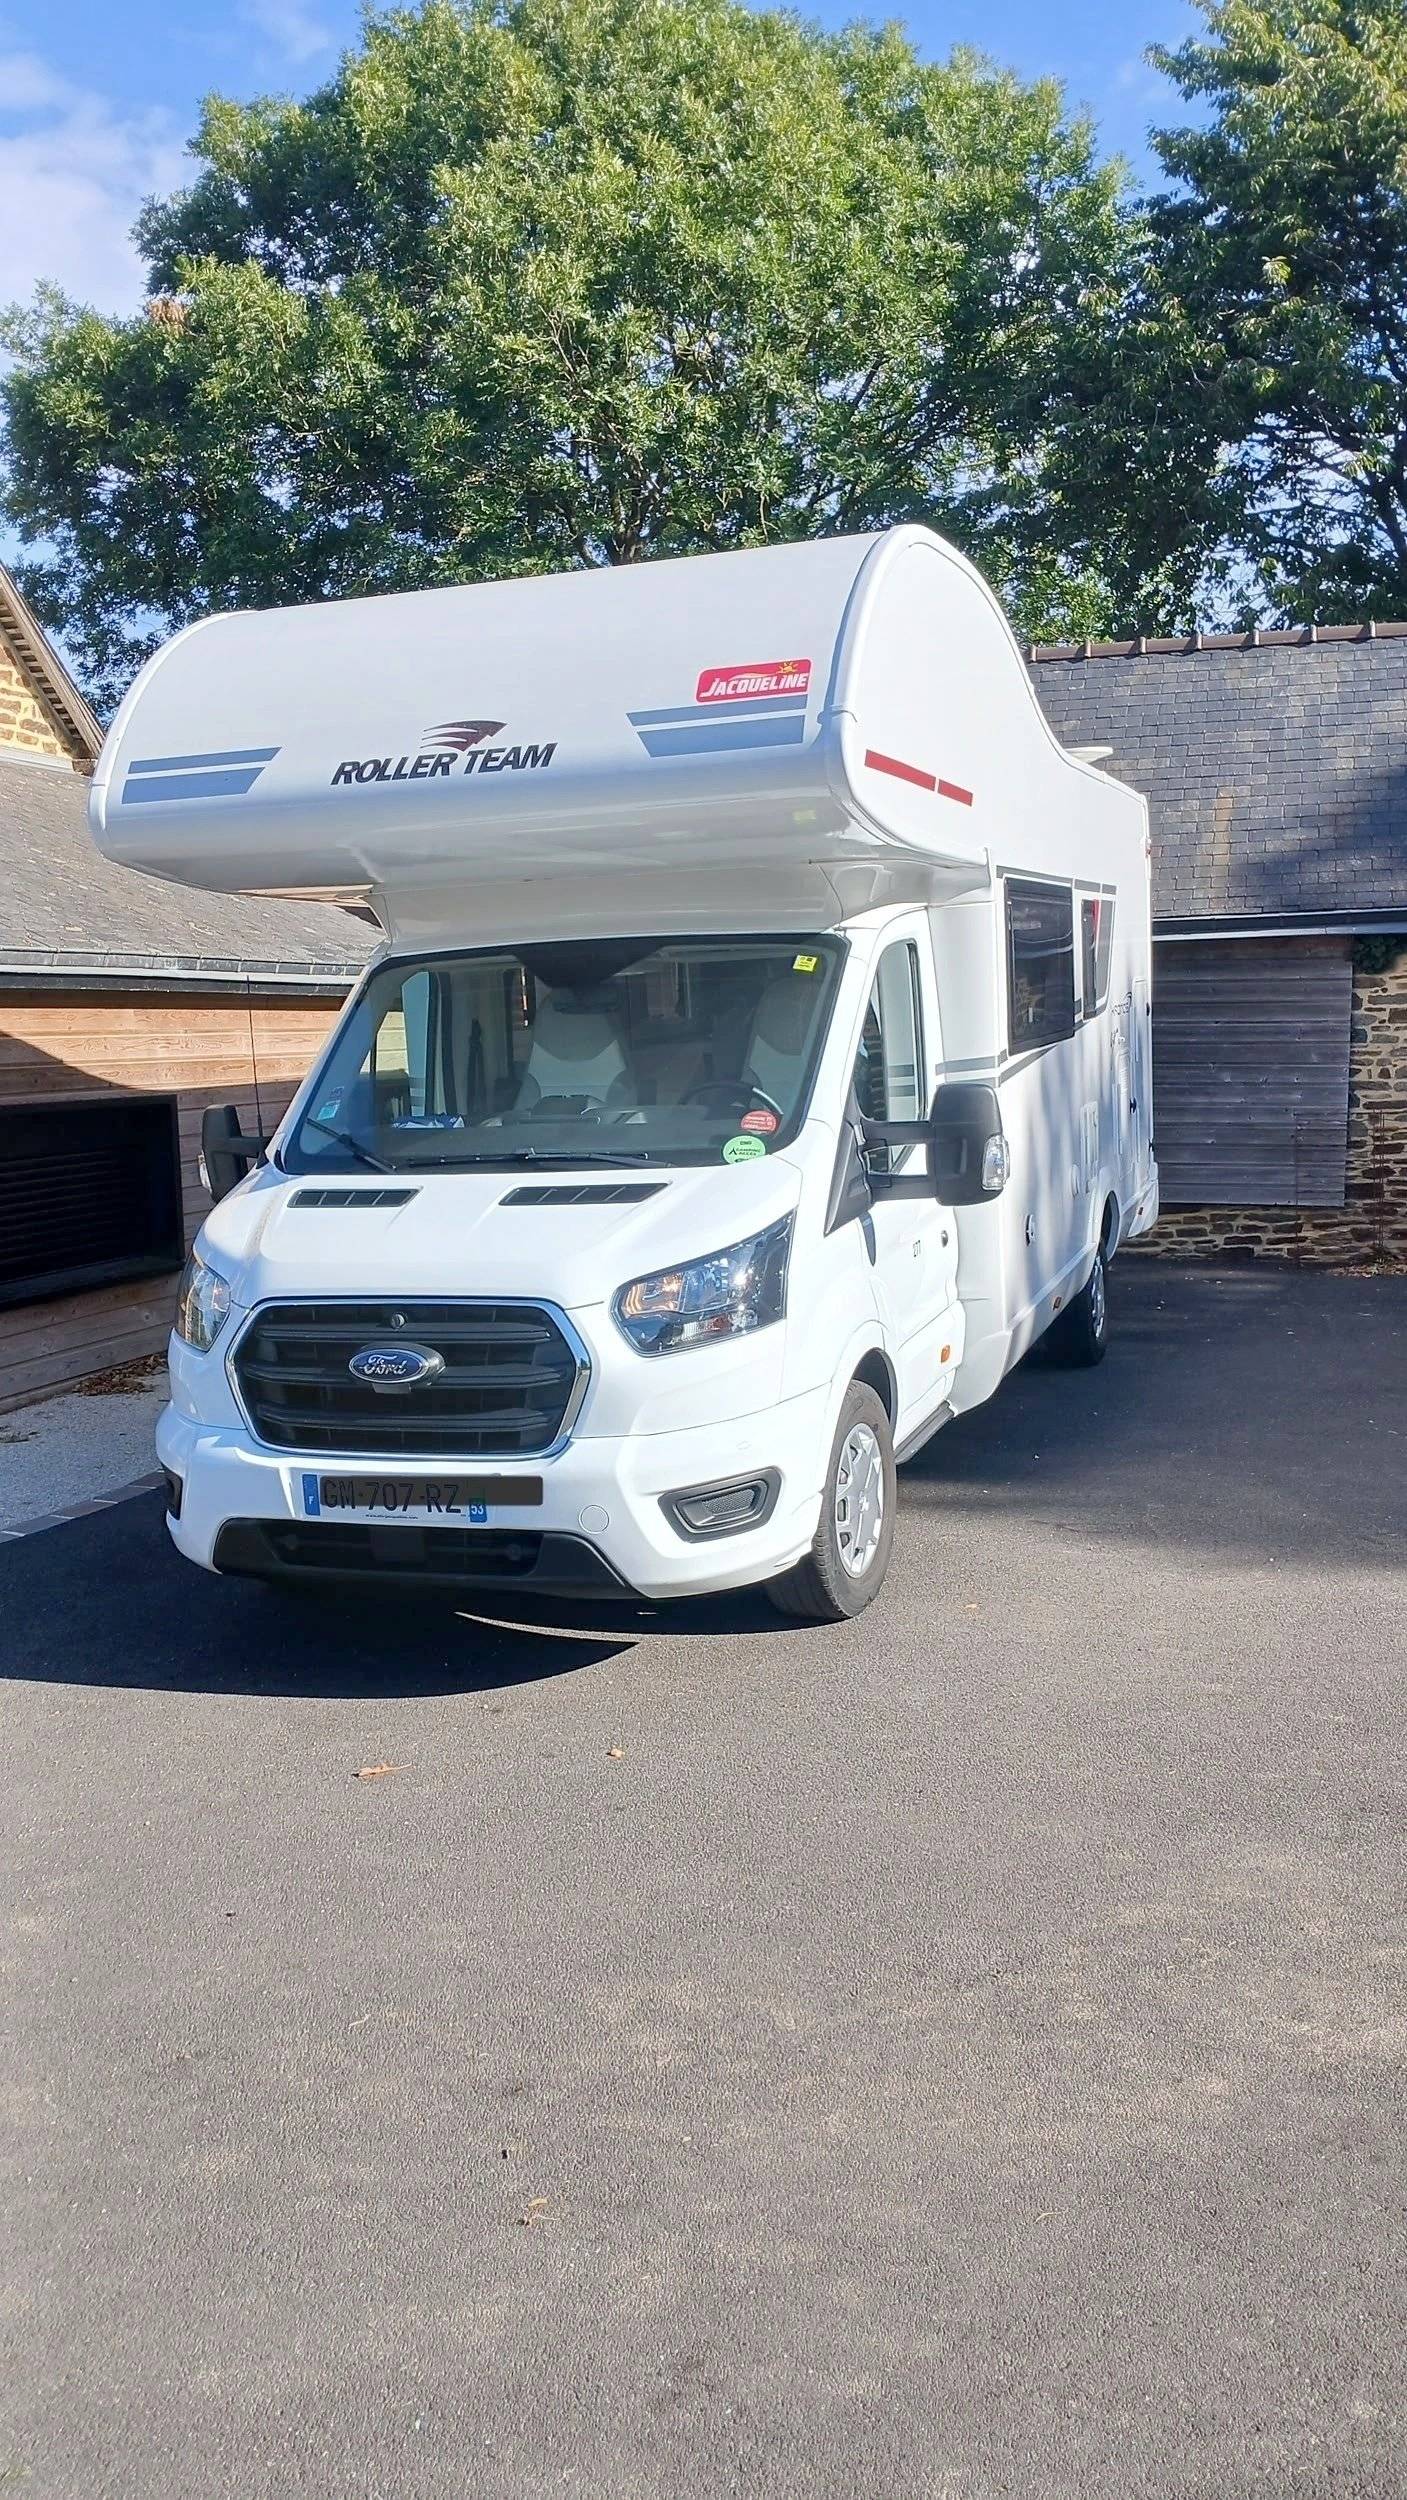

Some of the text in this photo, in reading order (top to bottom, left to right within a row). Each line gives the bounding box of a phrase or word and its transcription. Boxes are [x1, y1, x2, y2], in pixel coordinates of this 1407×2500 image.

[699, 673, 809, 698] JACQUELINE
[330, 742, 558, 785] ROLLER TEAM
[359, 1354, 407, 1375] Ford
[308, 1496, 315, 1505] F
[470, 1503, 485, 1515] 53
